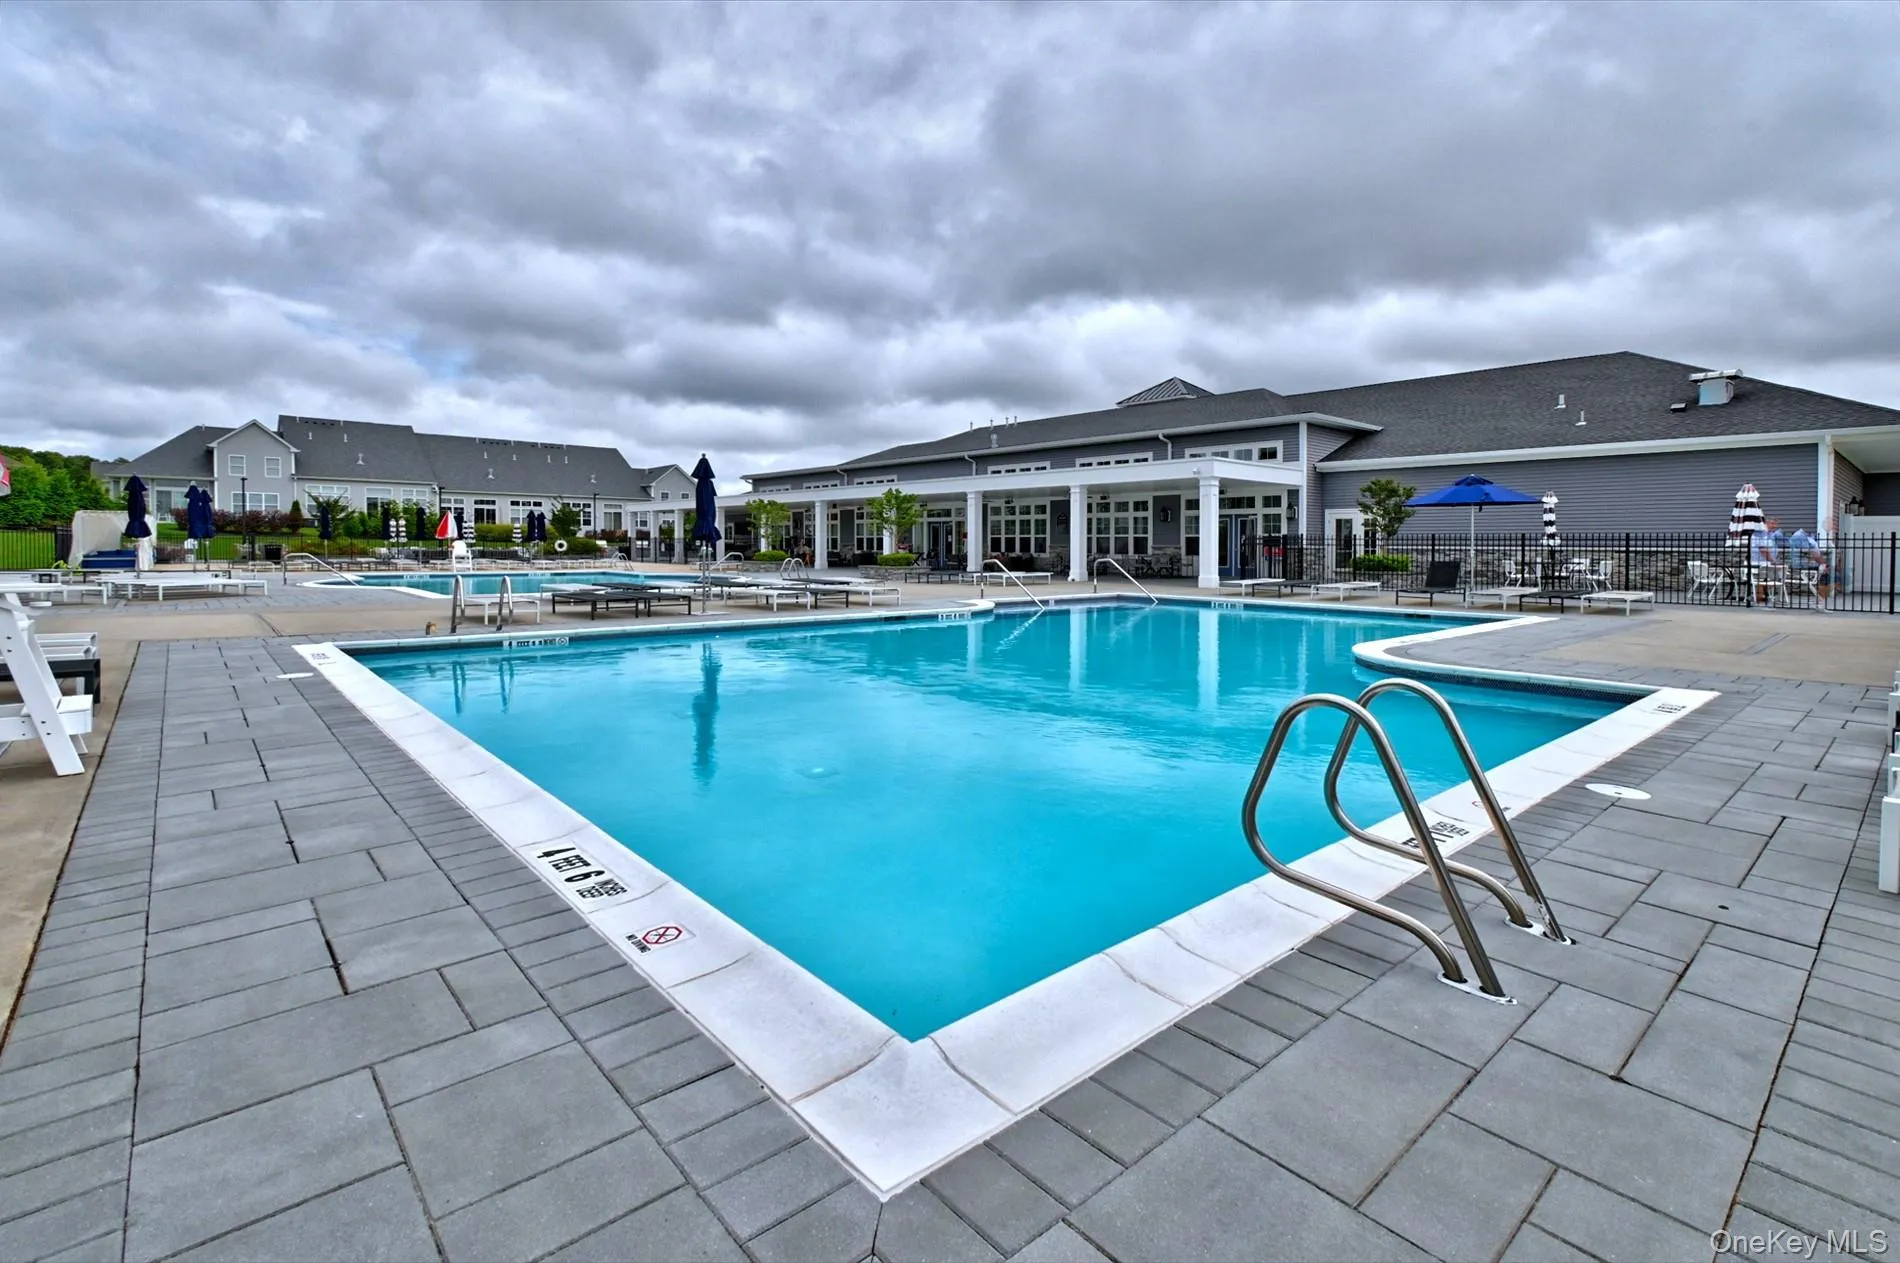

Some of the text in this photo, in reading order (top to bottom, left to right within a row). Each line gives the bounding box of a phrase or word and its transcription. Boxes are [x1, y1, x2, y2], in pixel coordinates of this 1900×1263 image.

[537, 846, 576, 858] 4
[548, 855, 592, 872] FEET
[564, 870, 606, 882] 6
